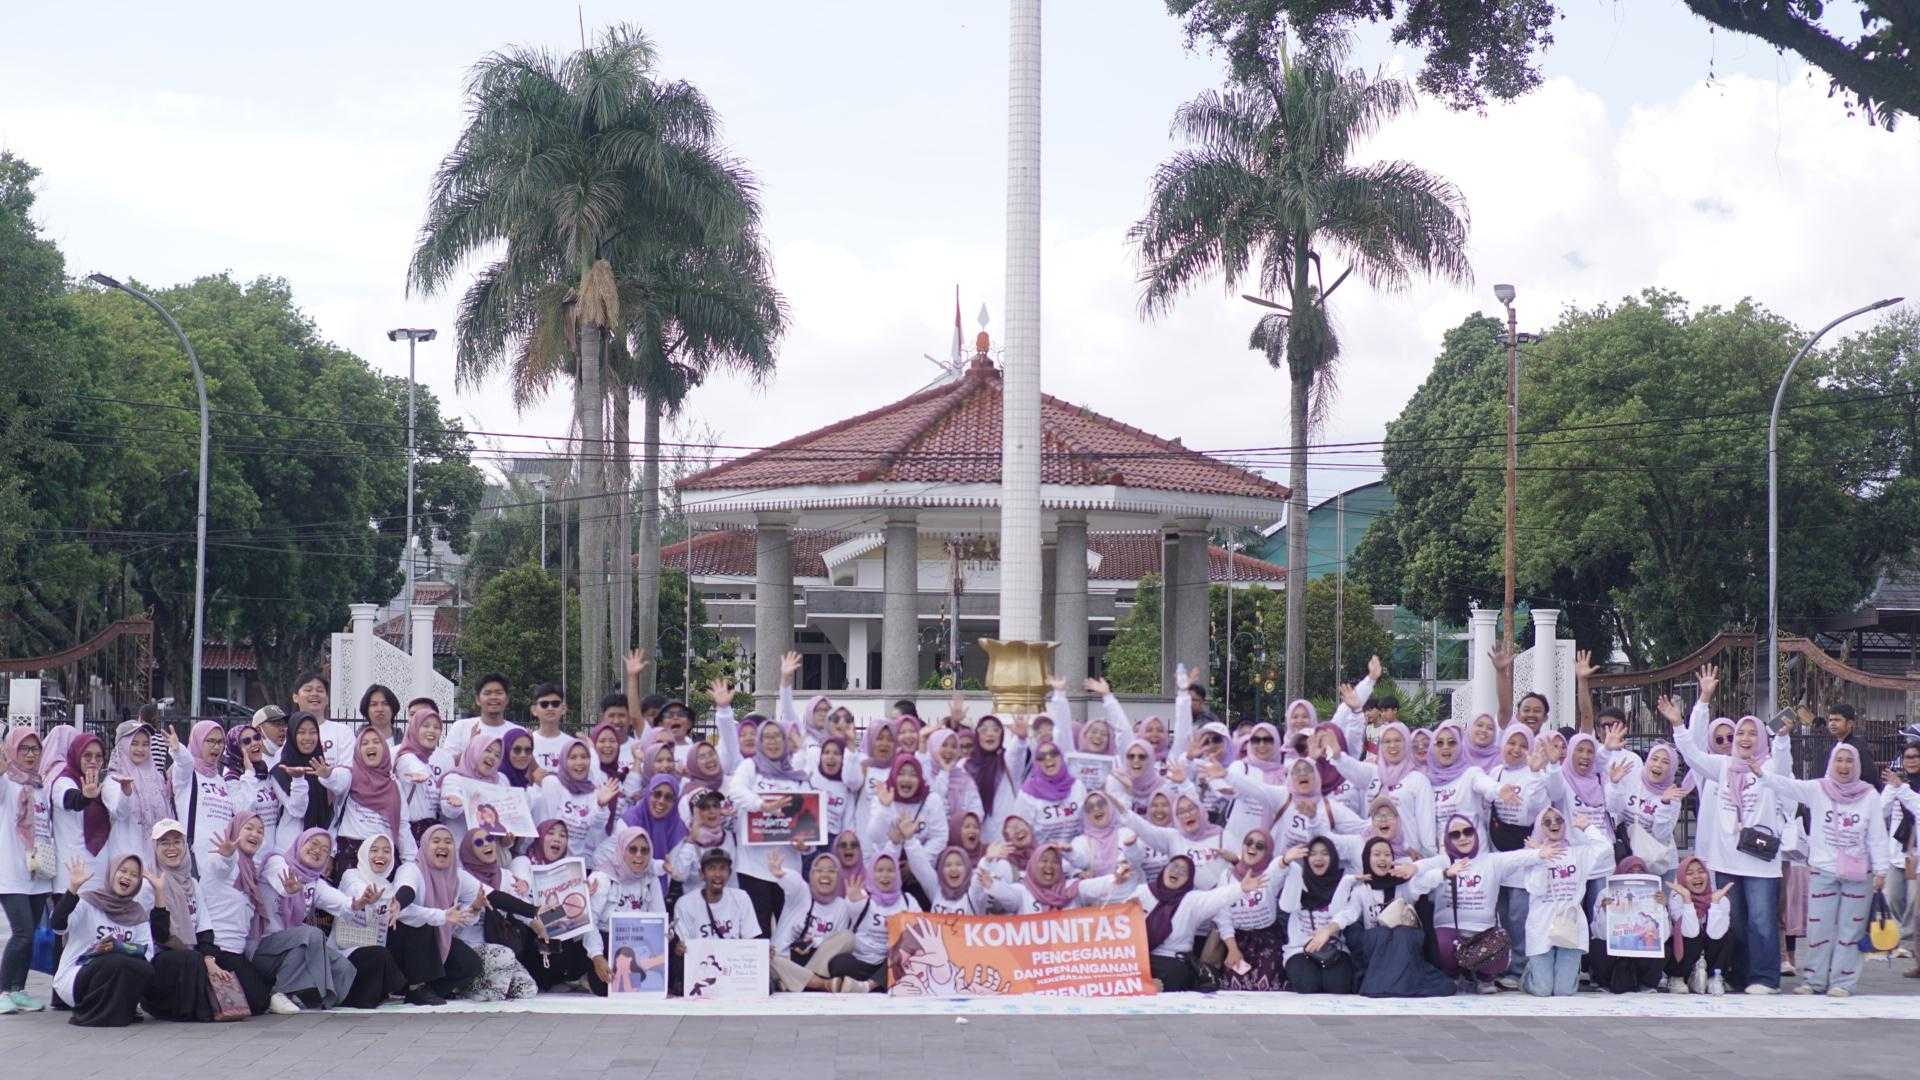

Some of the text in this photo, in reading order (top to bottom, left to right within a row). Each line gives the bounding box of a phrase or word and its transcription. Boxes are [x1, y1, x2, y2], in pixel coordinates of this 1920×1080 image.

[964, 914, 1132, 947] KOMUNITAS
[1032, 945, 1136, 966] PENCEGAHAN
[1014, 968, 1043, 980] DAN
[1045, 962, 1138, 977] PENANGANAN
